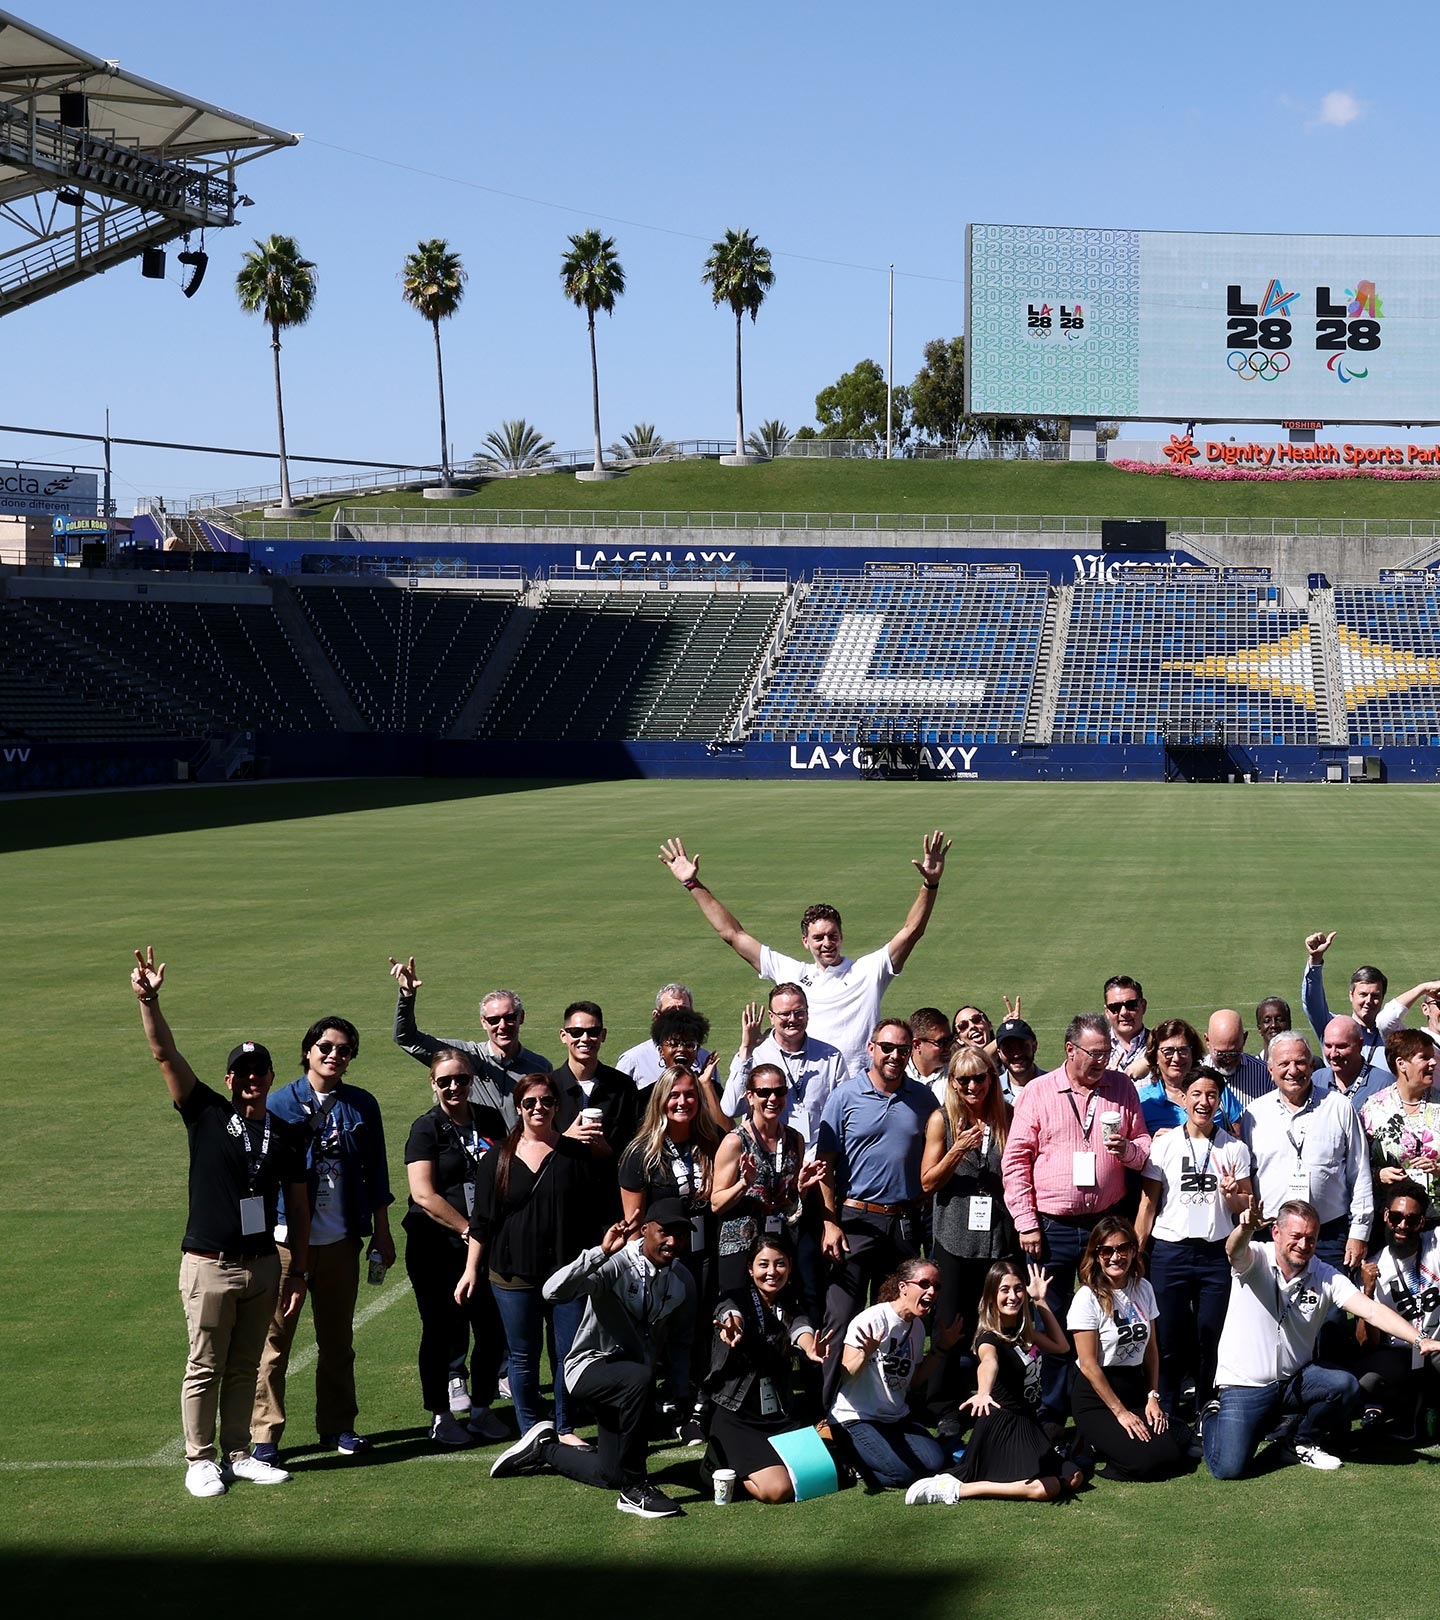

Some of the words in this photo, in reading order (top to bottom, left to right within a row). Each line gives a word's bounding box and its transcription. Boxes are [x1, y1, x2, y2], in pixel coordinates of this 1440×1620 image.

[1227, 279, 1300, 316] LA
[1316, 280, 1381, 318] LA
[1028, 304, 1053, 316] LA
[1060, 305, 1084, 316] LA
[1028, 317, 1051, 328] 28
[1060, 318, 1084, 329] 28
[1227, 318, 1292, 349] 28
[1316, 319, 1381, 351] 28
[1283, 421, 1322, 429] TOSHIBA
[1206, 442, 1274, 465] Dignity
[1277, 442, 1339, 462] Health
[1343, 443, 1402, 465] Sports
[1, 499, 26, 509] done
[29, 499, 70, 511] different
[66, 519, 90, 531] GOLDEN
[91, 519, 108, 530] ROAD
[790, 745, 831, 769] LA
[852, 746, 978, 770] GALAXY
[1181, 1174, 1218, 1192] 28
[1300, 1295, 1318, 1304] 28
[1117, 1323, 1148, 1346] 28
[883, 1357, 911, 1377] 28
